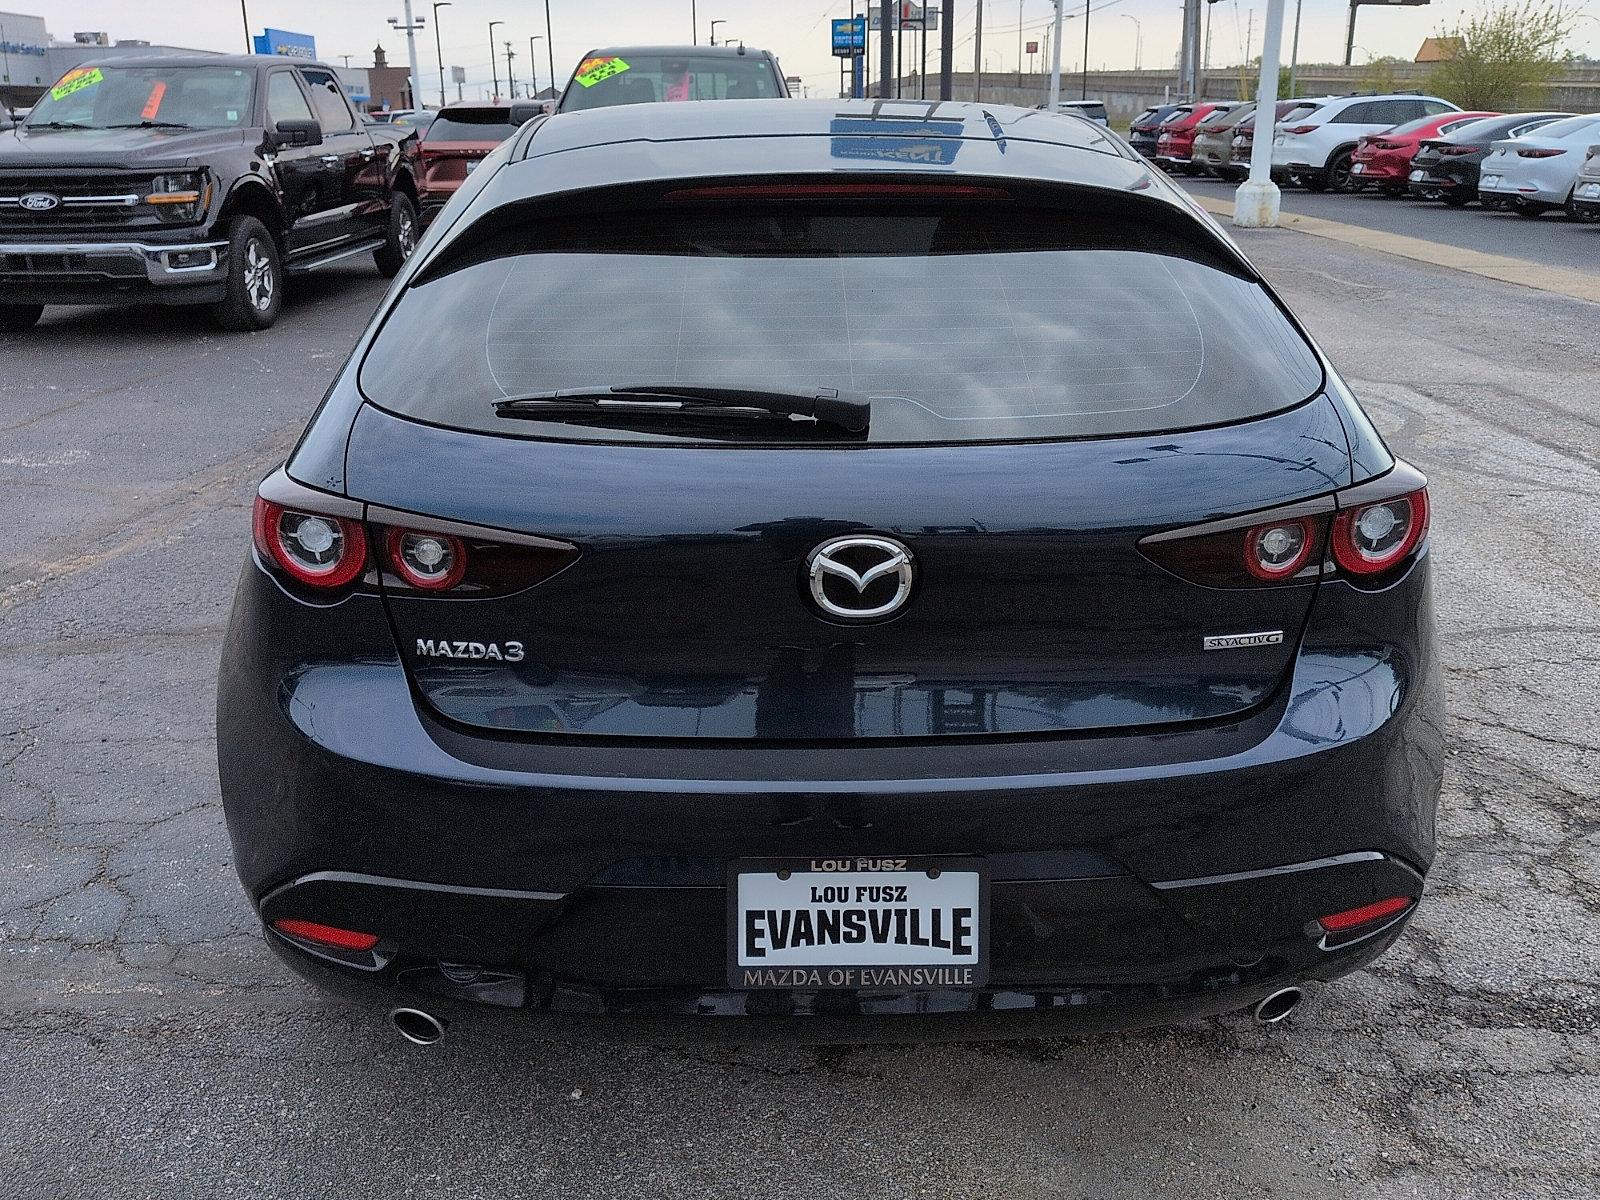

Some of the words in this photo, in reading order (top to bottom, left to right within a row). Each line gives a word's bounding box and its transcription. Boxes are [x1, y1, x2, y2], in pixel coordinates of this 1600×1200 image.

[27, 197, 50, 208] Ford
[810, 859, 851, 872] LOU
[856, 859, 908, 872] FUSZ
[810, 886, 850, 903] LOU
[855, 885, 908, 903] FUSZ
[745, 907, 973, 958] EVANSVILLE
[743, 969, 822, 987] MAZDA
[828, 969, 855, 986] OF
[860, 968, 973, 986] EVANSVILLE
